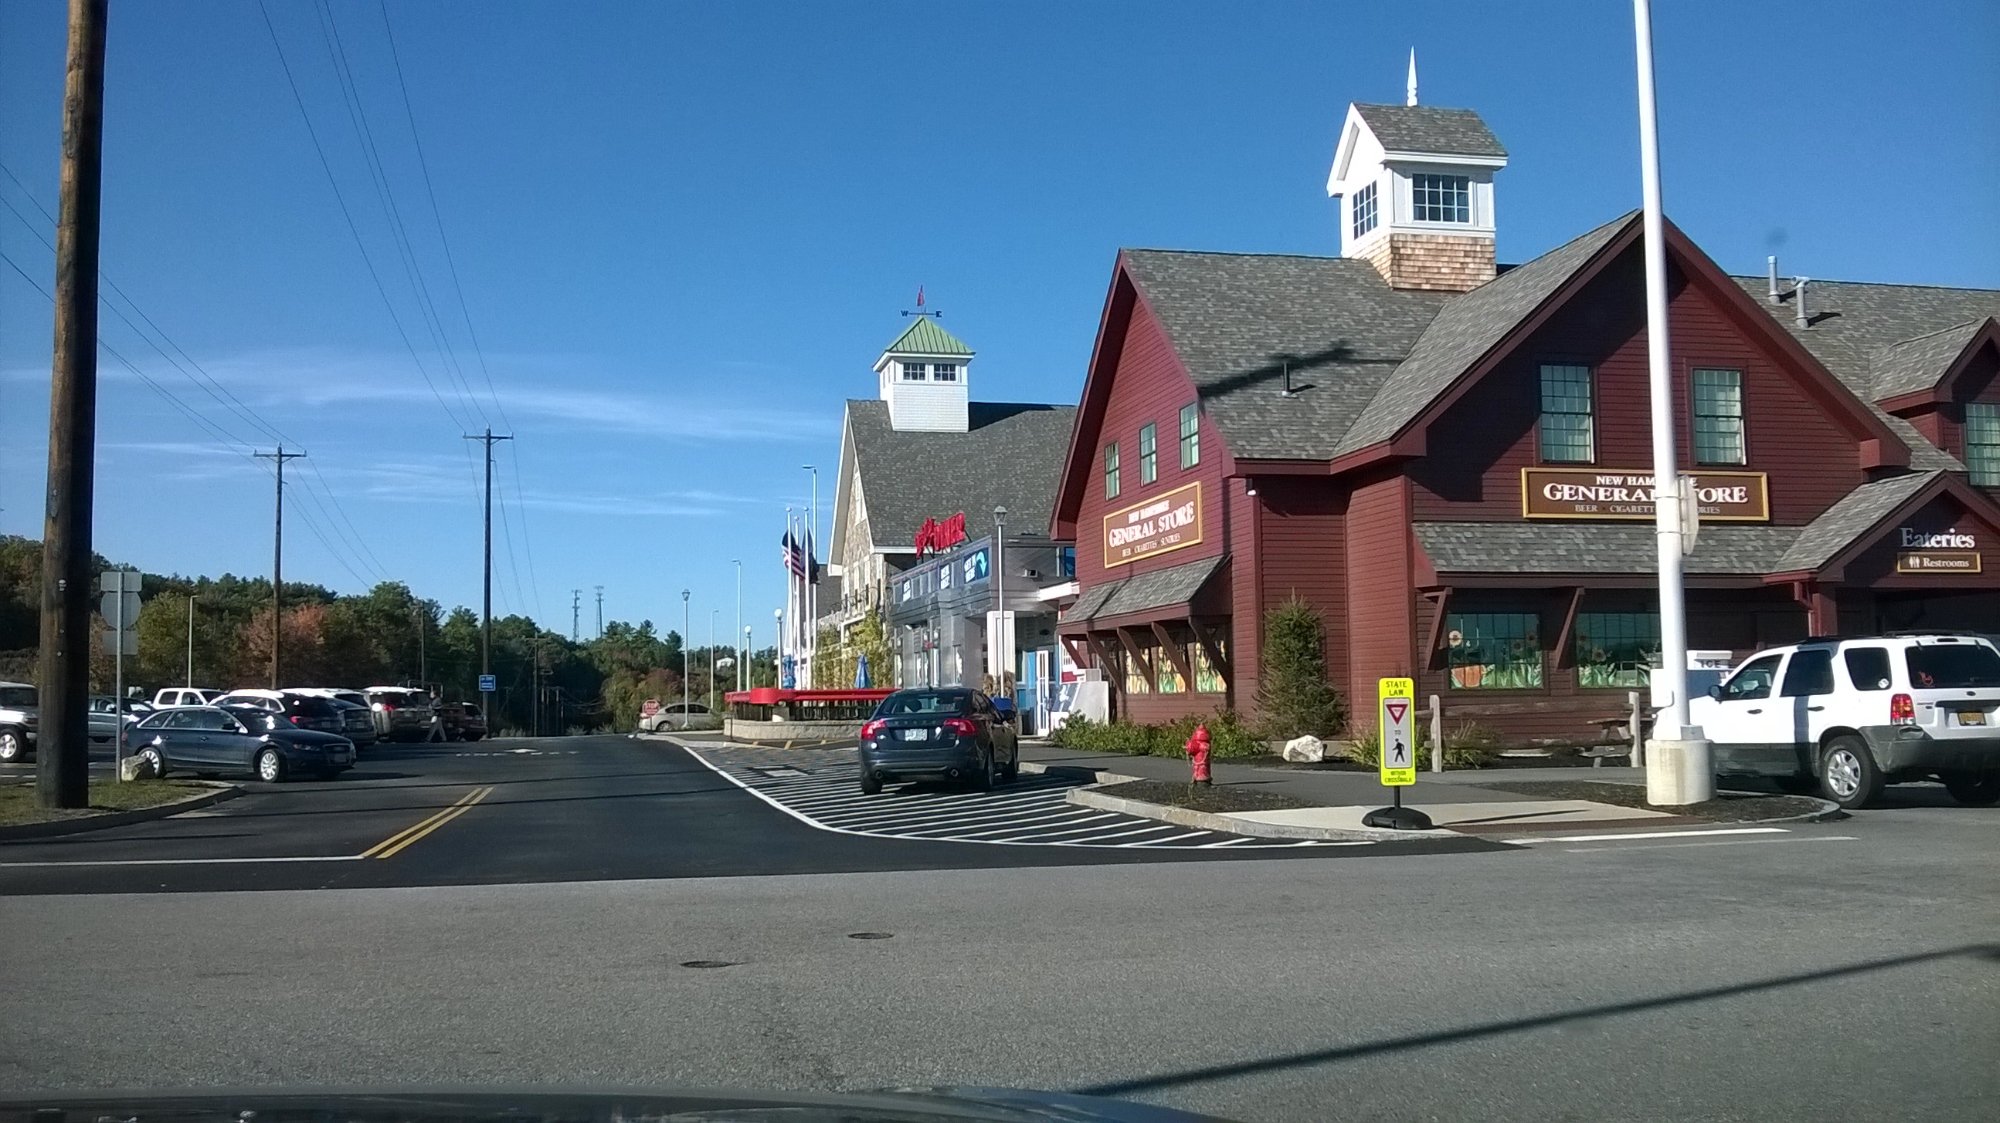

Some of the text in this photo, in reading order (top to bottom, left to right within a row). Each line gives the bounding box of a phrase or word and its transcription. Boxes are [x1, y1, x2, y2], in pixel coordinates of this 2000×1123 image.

[1596, 476, 1624, 486] NEW
[1575, 505, 1598, 513] BEER
[1109, 501, 1196, 548] GENERAL STORE
[1900, 527, 1976, 548] Eateries
[1923, 557, 1970, 568] Restrooms
[1701, 660, 1721, 668] ICE
